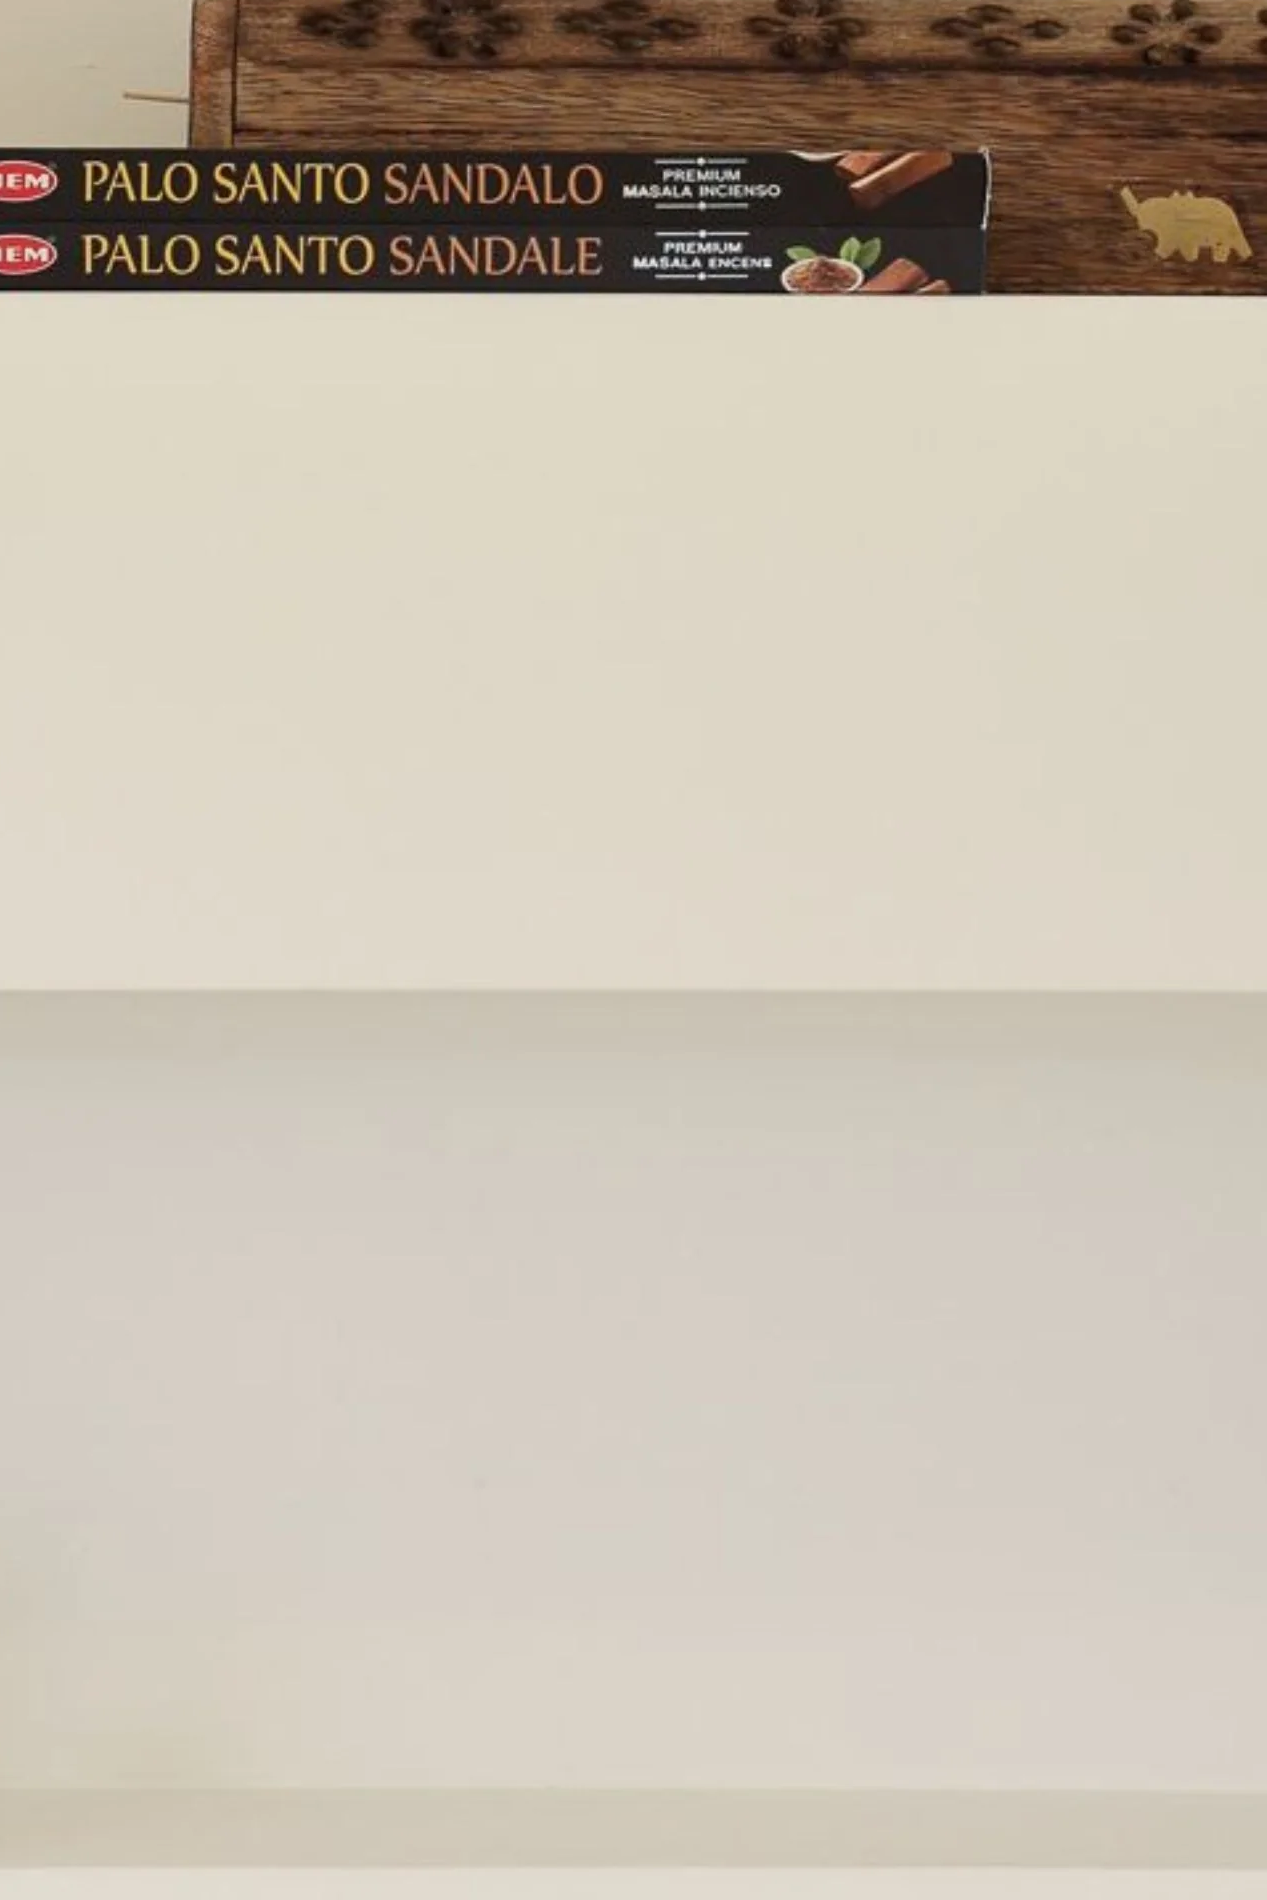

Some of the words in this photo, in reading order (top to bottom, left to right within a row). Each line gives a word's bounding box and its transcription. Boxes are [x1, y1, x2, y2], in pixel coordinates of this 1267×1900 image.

[82, 160, 199, 205] PALO
[213, 160, 371, 205] SANTO
[384, 162, 604, 205] SANDALO
[662, 168, 741, 183] PREMIUM
[622, 184, 693, 199] MASALA
[699, 184, 781, 199] INCIENSO
[82, 233, 201, 276] PALO
[214, 233, 376, 276] SANTO
[389, 235, 603, 276] SANDALE
[663, 241, 743, 254] PREMIUM
[633, 256, 702, 269] MASALA
[708, 256, 773, 269] ENCENS
